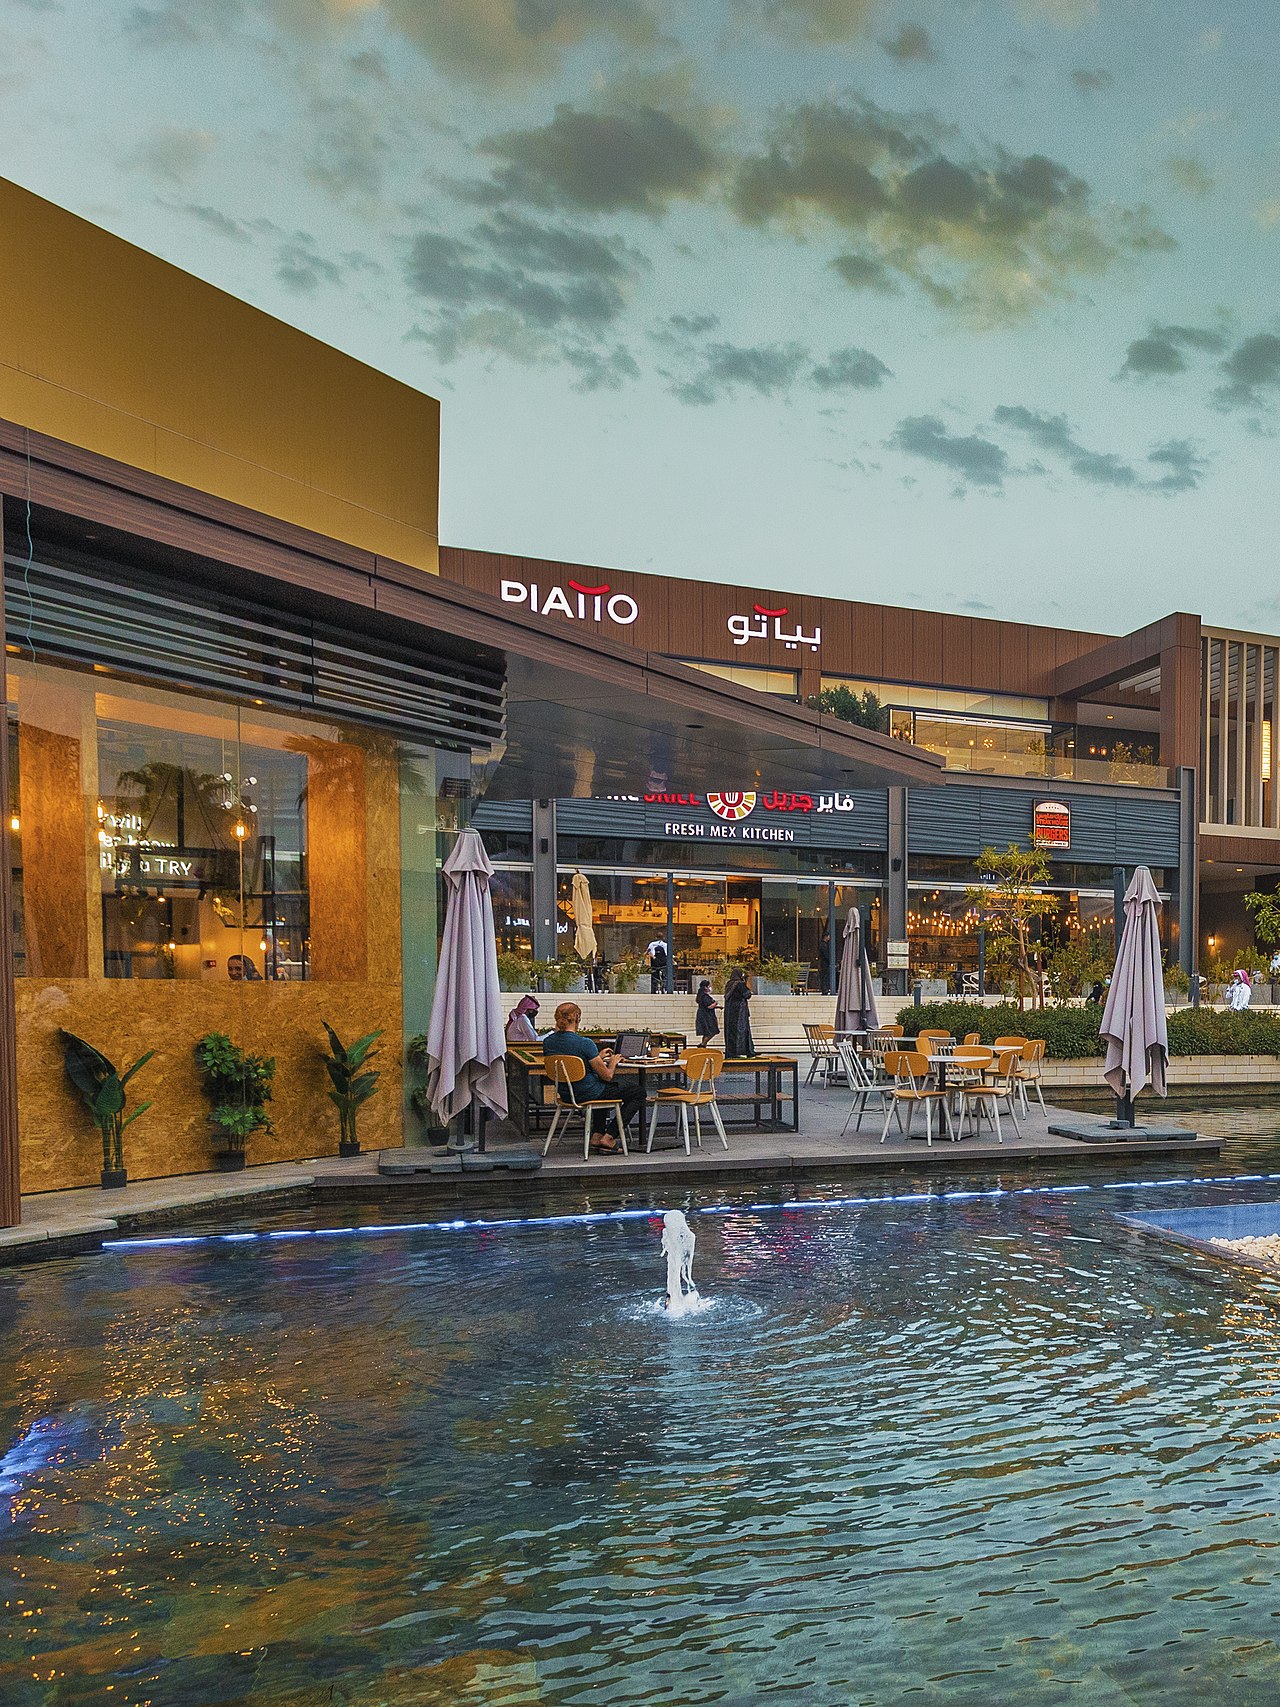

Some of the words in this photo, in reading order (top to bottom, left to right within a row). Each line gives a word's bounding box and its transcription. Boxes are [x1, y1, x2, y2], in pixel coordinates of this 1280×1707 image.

[500, 580, 639, 625] PIATTO
[728, 608, 821, 652] بياتو
[762, 790, 814, 813] جريل
[816, 792, 855, 813] فاير
[664, 823, 704, 836] FRESH
[710, 825, 737, 839] MEX
[742, 827, 794, 842] KITCHEN
[154, 858, 193, 876] TRY
